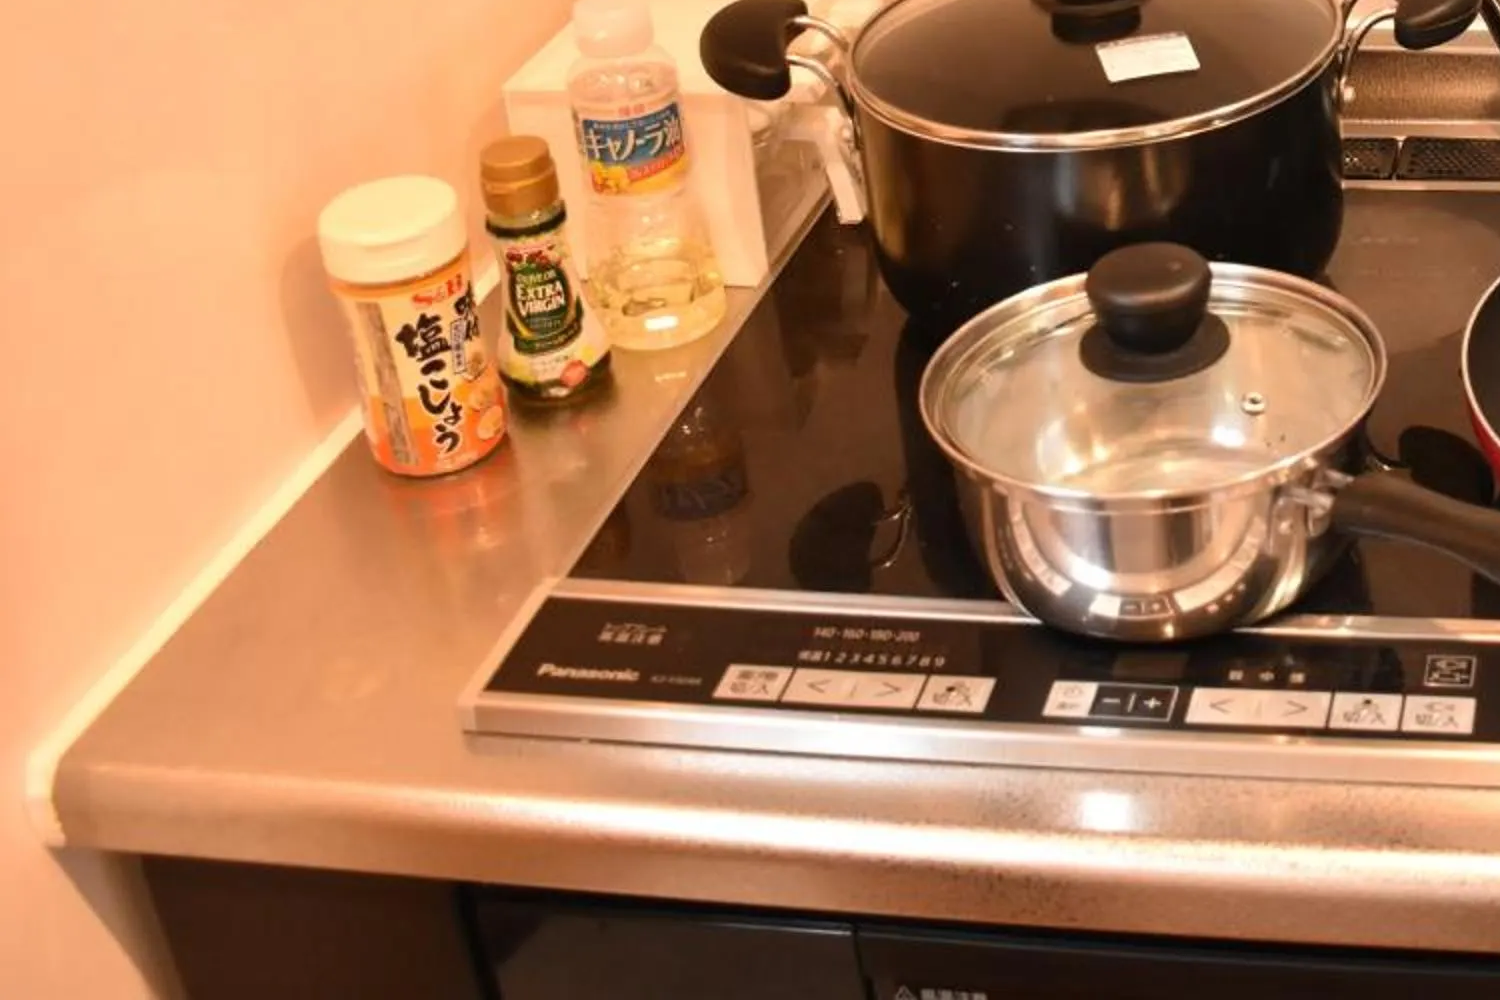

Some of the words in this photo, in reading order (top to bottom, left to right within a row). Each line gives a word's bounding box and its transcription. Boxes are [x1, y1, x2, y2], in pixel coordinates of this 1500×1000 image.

[515, 280, 563, 301] EXTRA
[517, 297, 566, 318] VIRGIN
[395, 313, 462, 452] 塩こしょう
[537, 662, 641, 682] Panasonic
